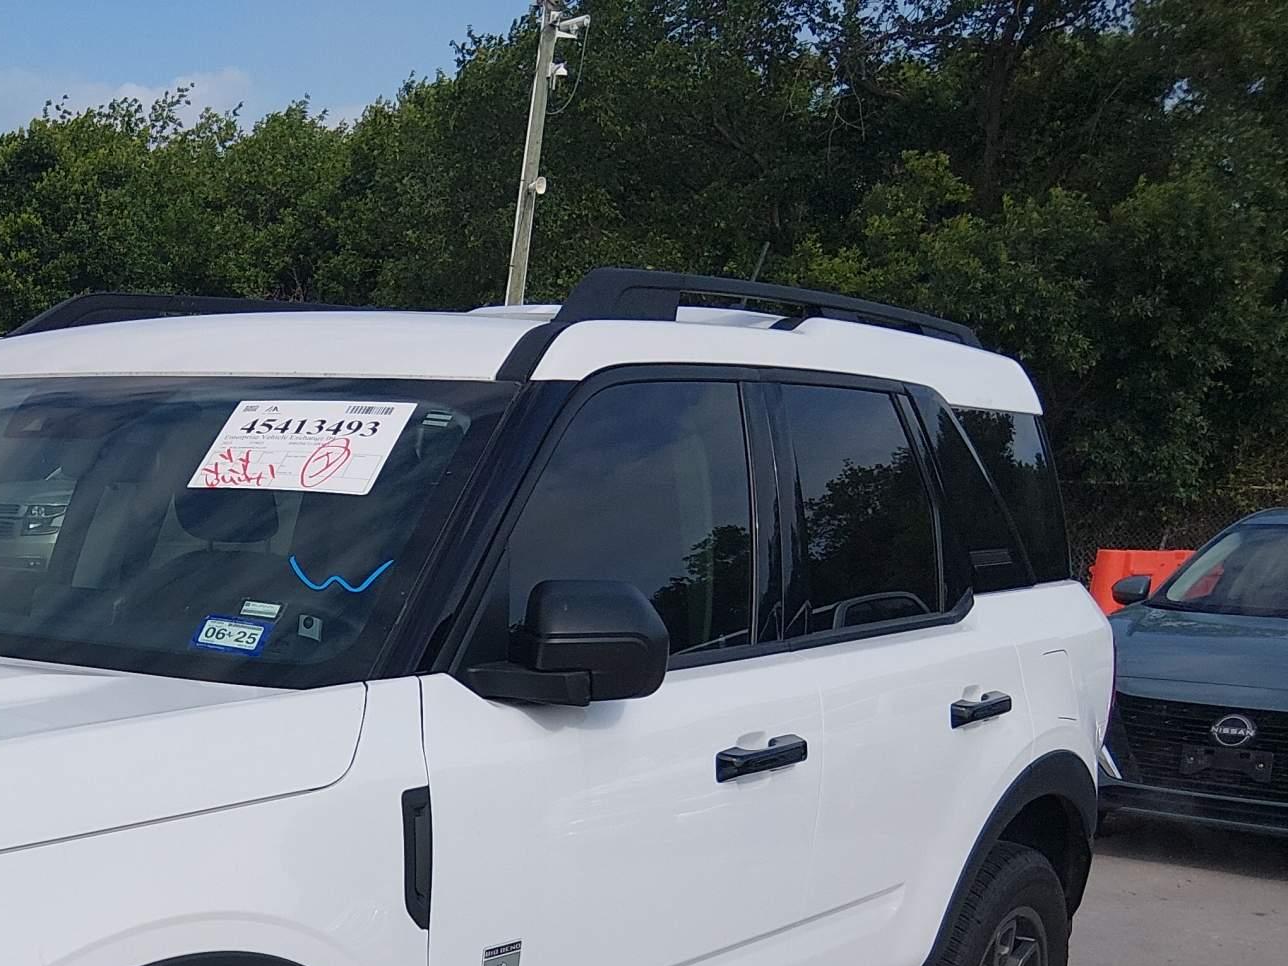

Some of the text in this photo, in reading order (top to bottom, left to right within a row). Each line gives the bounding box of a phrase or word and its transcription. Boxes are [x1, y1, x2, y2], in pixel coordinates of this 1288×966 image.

[240, 418, 381, 437] 45413493
[204, 626, 227, 640] 06
[233, 630, 258, 645] 25
[1210, 725, 1256, 737] NISSAN
